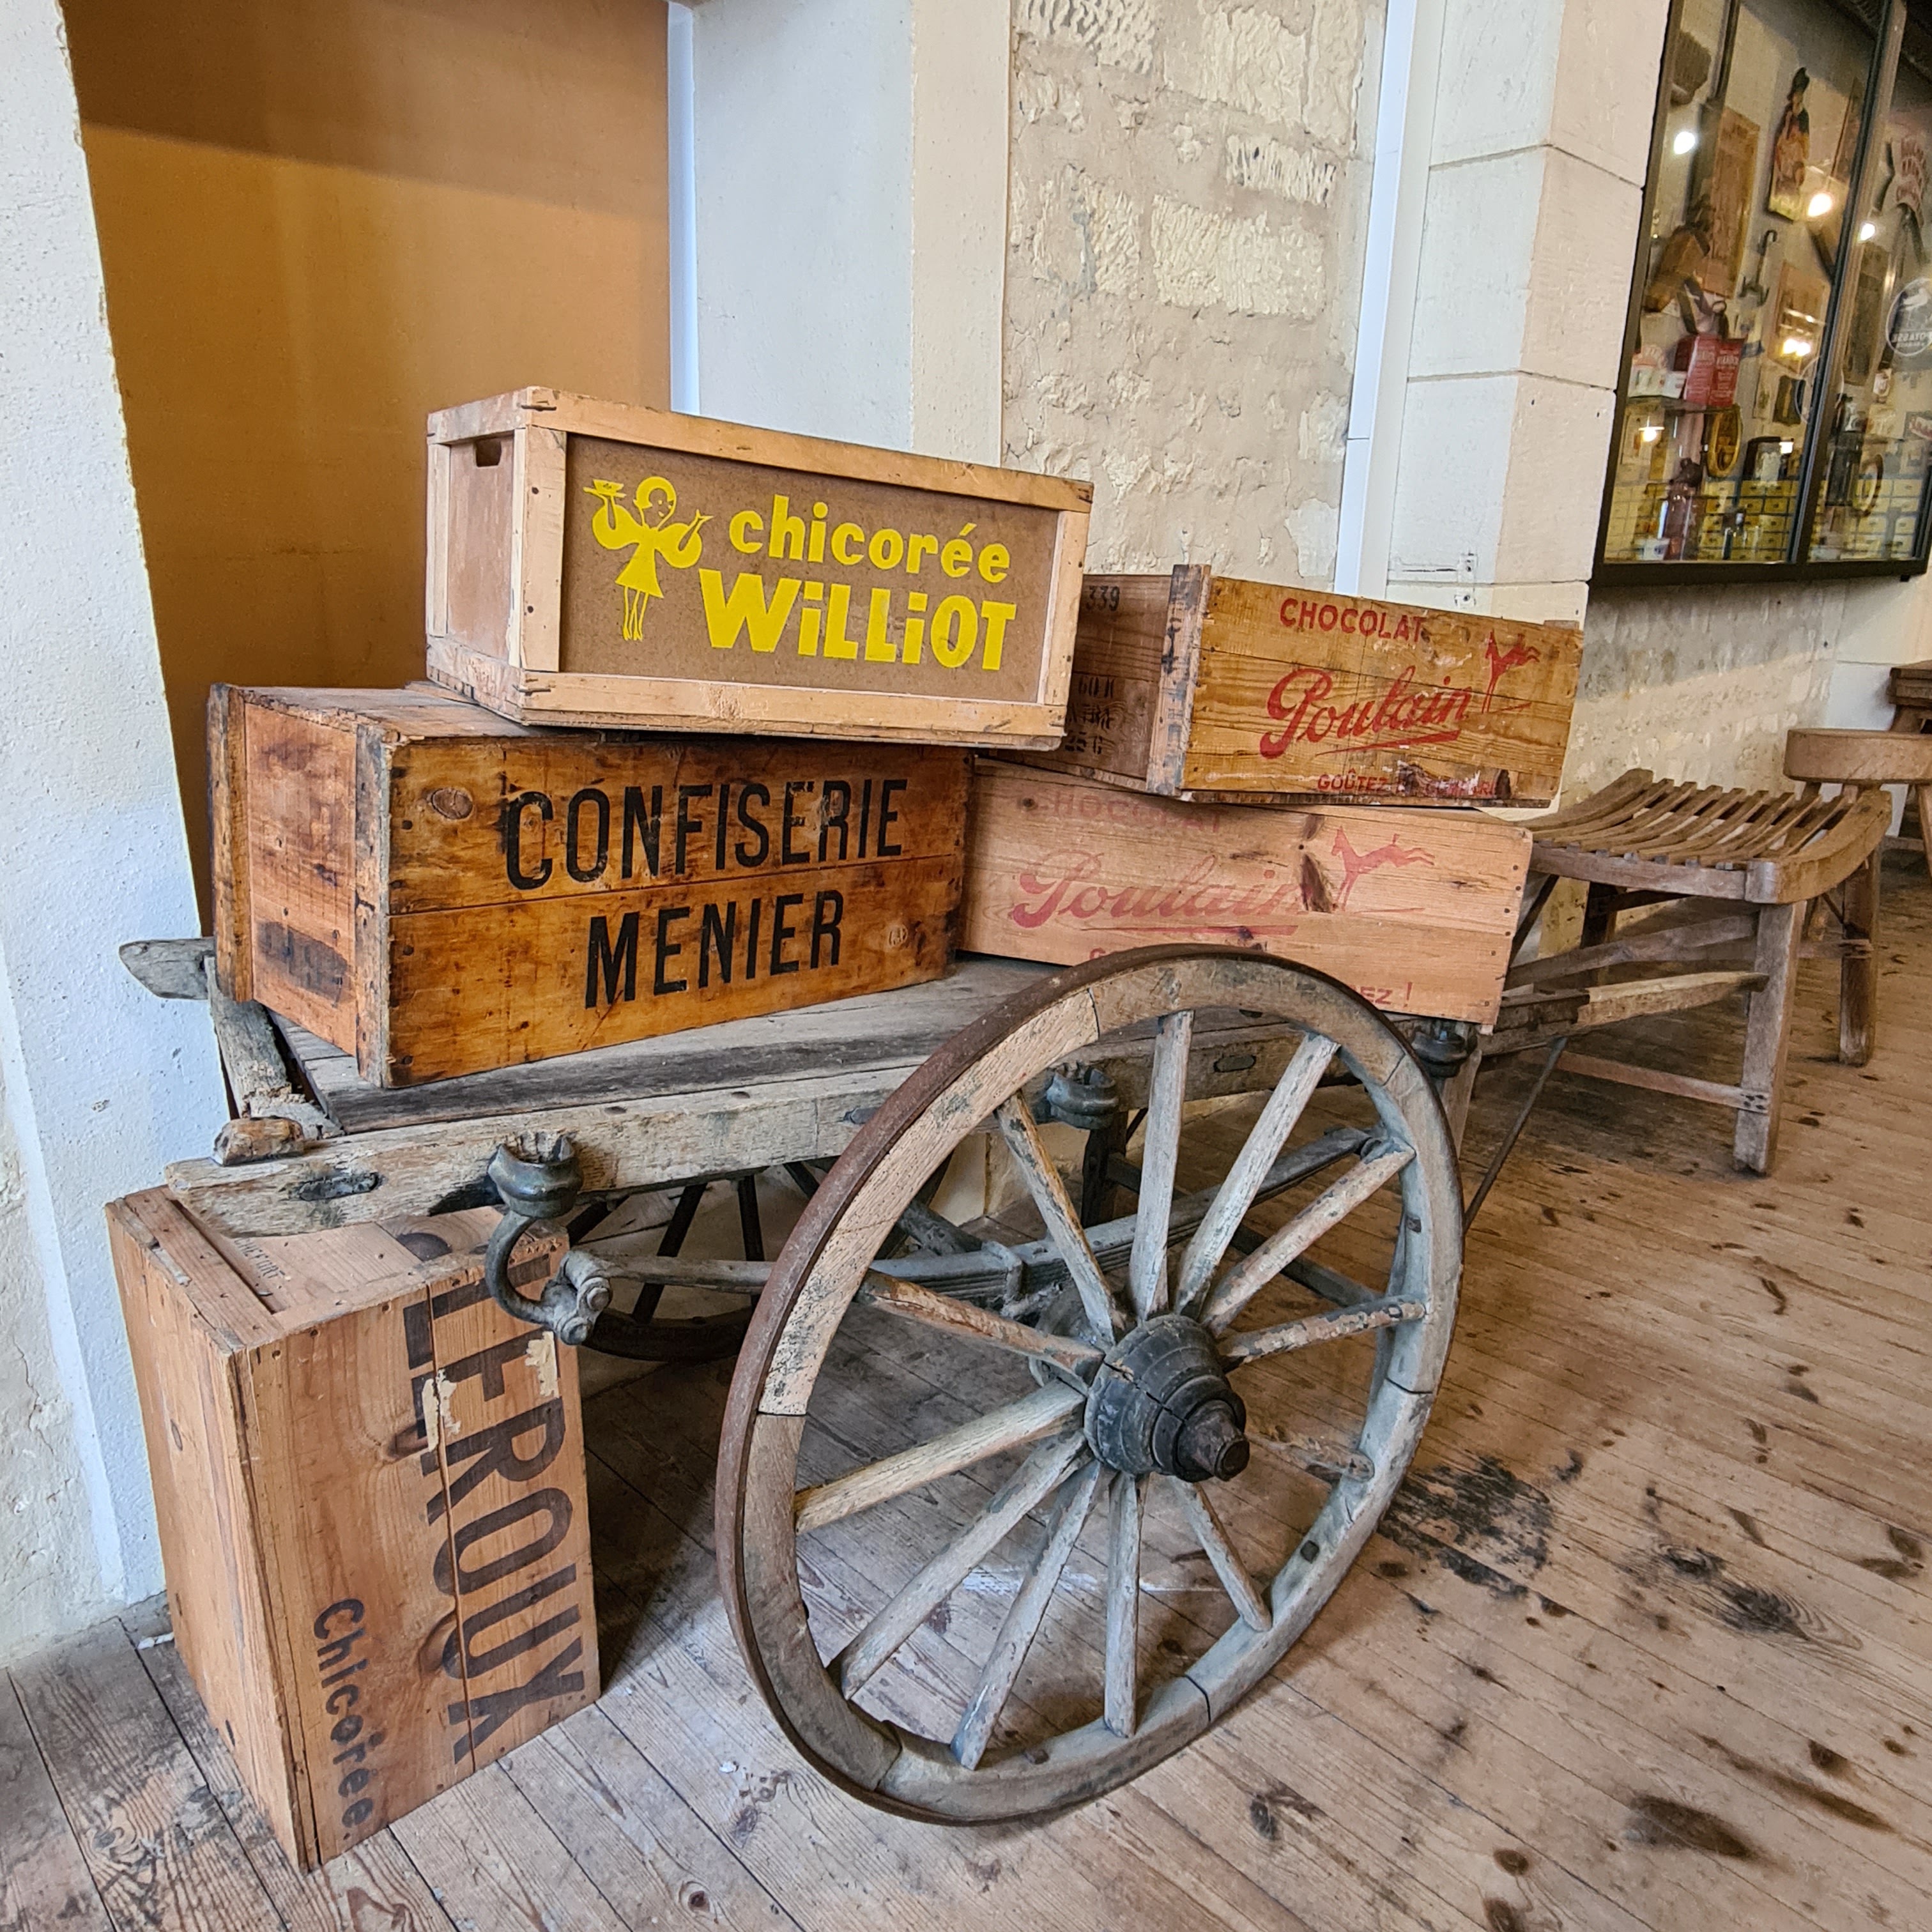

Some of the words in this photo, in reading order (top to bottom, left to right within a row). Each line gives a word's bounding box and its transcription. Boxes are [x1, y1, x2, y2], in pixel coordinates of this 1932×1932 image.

[729, 494, 1011, 583] chicorée
[1280, 597, 1427, 642] CHOCOLAT
[1259, 664, 1473, 760] Poulain
[1317, 769, 1389, 792] GOÛTEZ
[506, 778, 907, 891] CONFISERIE
[1011, 850, 1307, 928] Poulain
[584, 889, 843, 1009] MENIER
[402, 1254, 586, 1765] LEROUX
